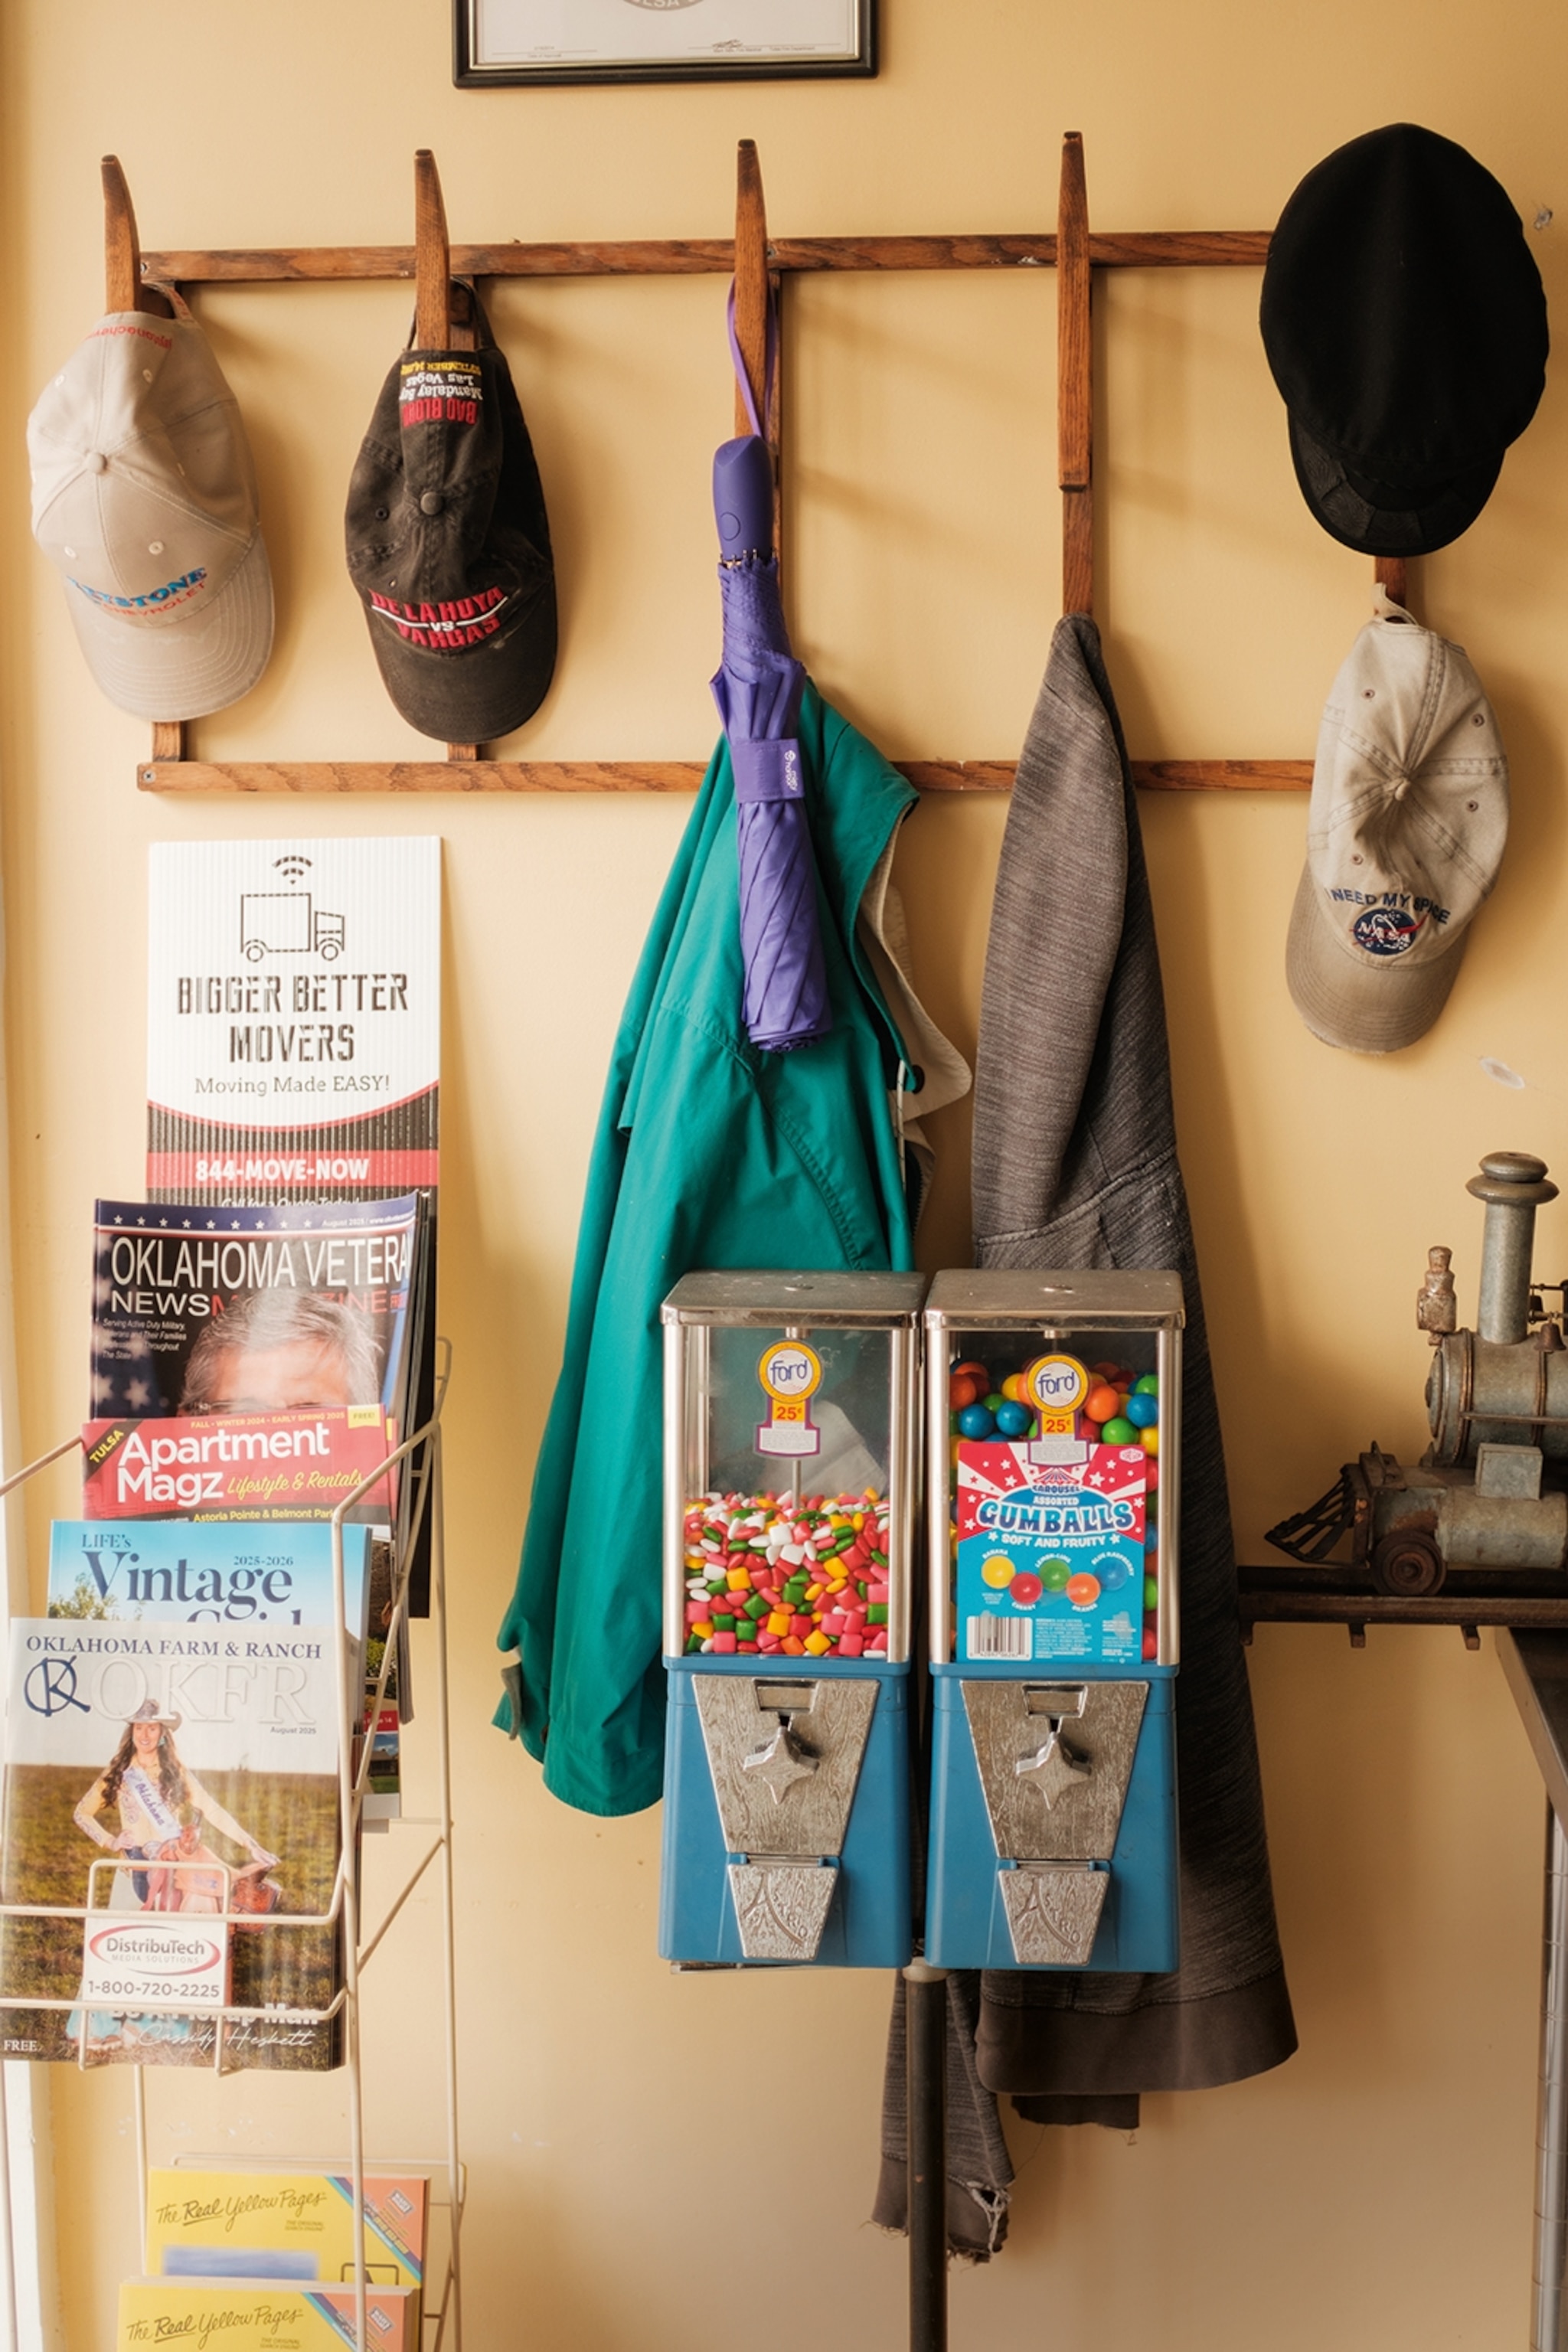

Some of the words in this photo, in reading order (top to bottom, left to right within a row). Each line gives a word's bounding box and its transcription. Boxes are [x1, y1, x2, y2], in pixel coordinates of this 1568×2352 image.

[406, 372, 443, 387] Vegas
[447, 374, 474, 386] Las
[417, 384, 483, 400] Mandalay
[446, 397, 476, 424] BAD
[368, 587, 400, 615] DE
[395, 614, 501, 648] VARGAS
[1331, 888, 1377, 905] NEED
[1383, 893, 1411, 907] MY
[1358, 921, 1411, 943] NASA
[178, 975, 282, 1014] BIGGER
[293, 973, 409, 1013] BETTER
[230, 1024, 355, 1063] MOVERS
[194, 1078, 268, 1097] Moving
[273, 1076, 327, 1093] Made
[333, 1074, 390, 1093] EASY!
[195, 1158, 370, 1182] 844-MOVE-NOW
[111, 1236, 297, 1289] OKLAHOMA
[770, 1360, 808, 1385] ford
[1038, 1372, 1075, 1398] ford
[216, 1418, 246, 1427] WINTER
[272, 1414, 296, 1423] EARLY
[298, 1413, 325, 1422] SPRING
[89, 1429, 125, 1464] TULSA
[118, 1423, 330, 1472] Apartment
[117, 1468, 224, 1508] Magz
[227, 1478, 289, 1500] Lifestyle
[293, 1478, 305, 1491] &
[307, 1468, 364, 1487] Rentals
[1033, 1496, 1080, 1506] ASSORTED
[194, 1513, 228, 1523] Astoria
[230, 1510, 259, 1521] Pointe
[272, 1508, 312, 1519] Belmont
[977, 1500, 1135, 1534] GUMBALLS
[82, 1534, 131, 1548] LIFE's
[1001, 1534, 1033, 1546] SOFT
[1034, 1536, 1061, 1547] AND
[1063, 1536, 1106, 1547] FRUITY
[234, 1556, 294, 1567] 2025-2026
[82, 1551, 292, 1619] Vintage
[26, 1635, 153, 1655] OKLAHOMA
[159, 1639, 219, 1657] FARM
[224, 1642, 240, 1657] &
[246, 1641, 322, 1659] RANCH
[270, 1726, 297, 1736] August
[107, 1937, 205, 1955] DistribuTech
[112, 1954, 142, 1962] MEDIA
[146, 1955, 199, 1964] SOLUTIONS
[88, 1980, 220, 1999] 1-800-720-2225
[155, 2203, 181, 2224] The
[182, 2200, 224, 2222] Real
[225, 2193, 279, 2233] Yellow
[279, 2188, 325, 2218] Pages
[126, 2320, 153, 2341] The
[154, 2314, 197, 2337] Real
[198, 2310, 253, 2350] Yellow
[253, 2305, 302, 2335] Pages
